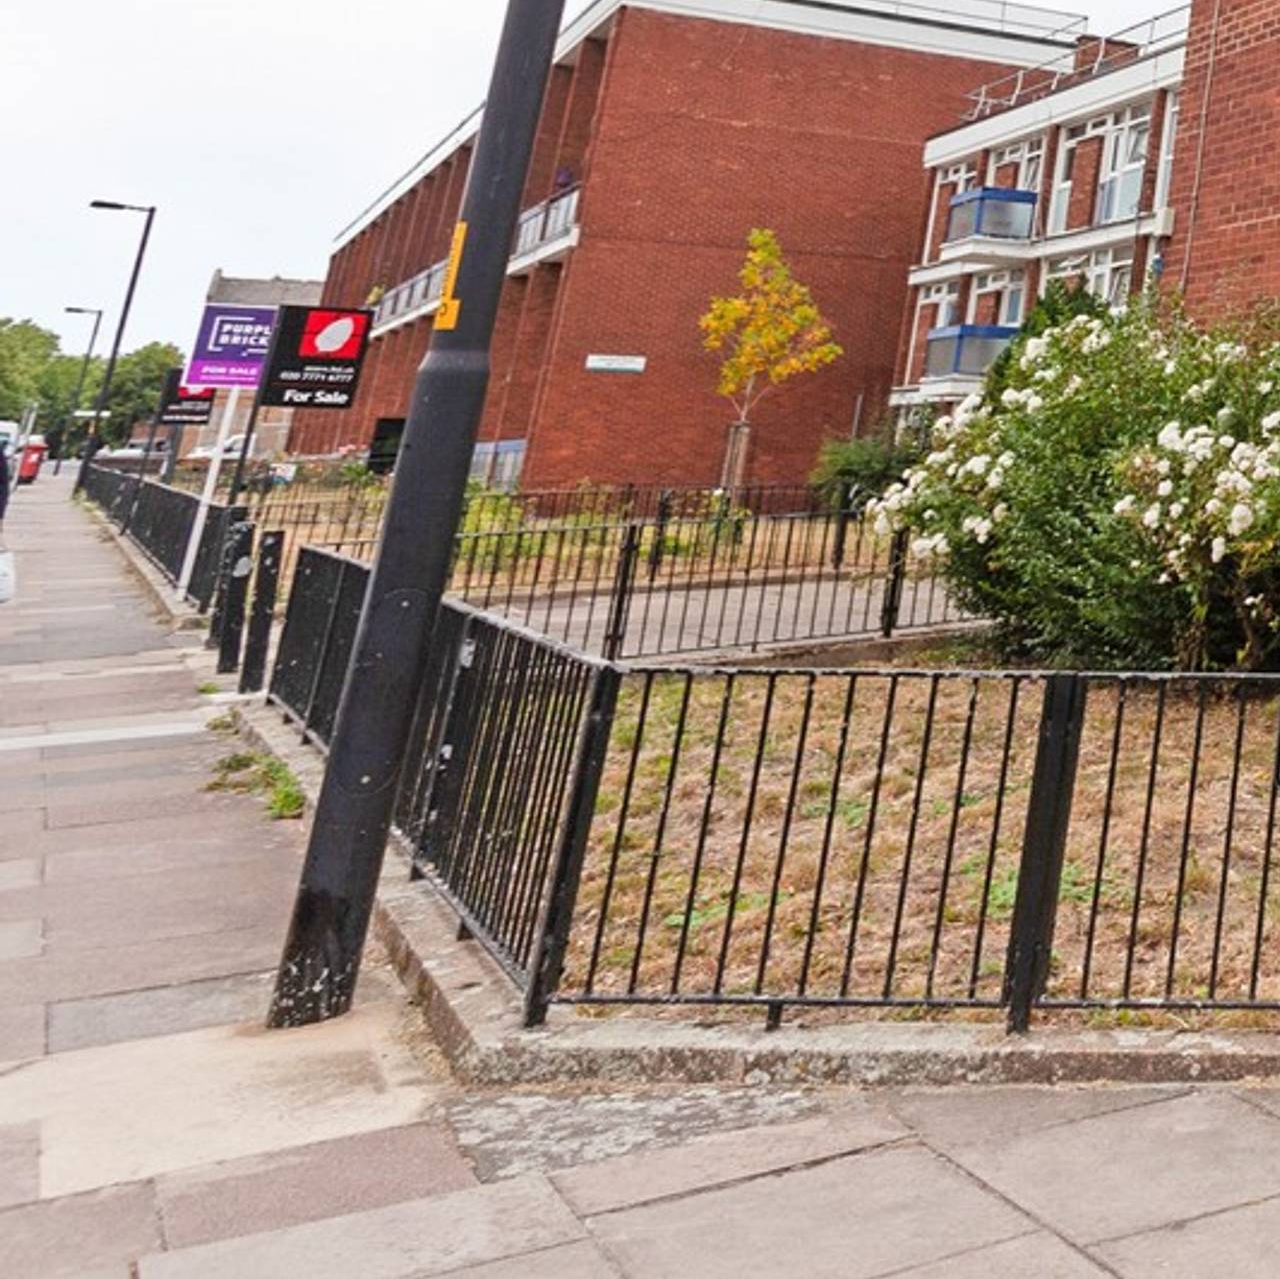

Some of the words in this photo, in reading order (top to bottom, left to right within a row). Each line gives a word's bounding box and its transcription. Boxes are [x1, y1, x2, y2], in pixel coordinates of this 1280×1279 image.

[222, 324, 272, 335] PURPL
[218, 334, 269, 346] BRICK
[283, 389, 312, 402] For
[313, 390, 348, 404] Sale
